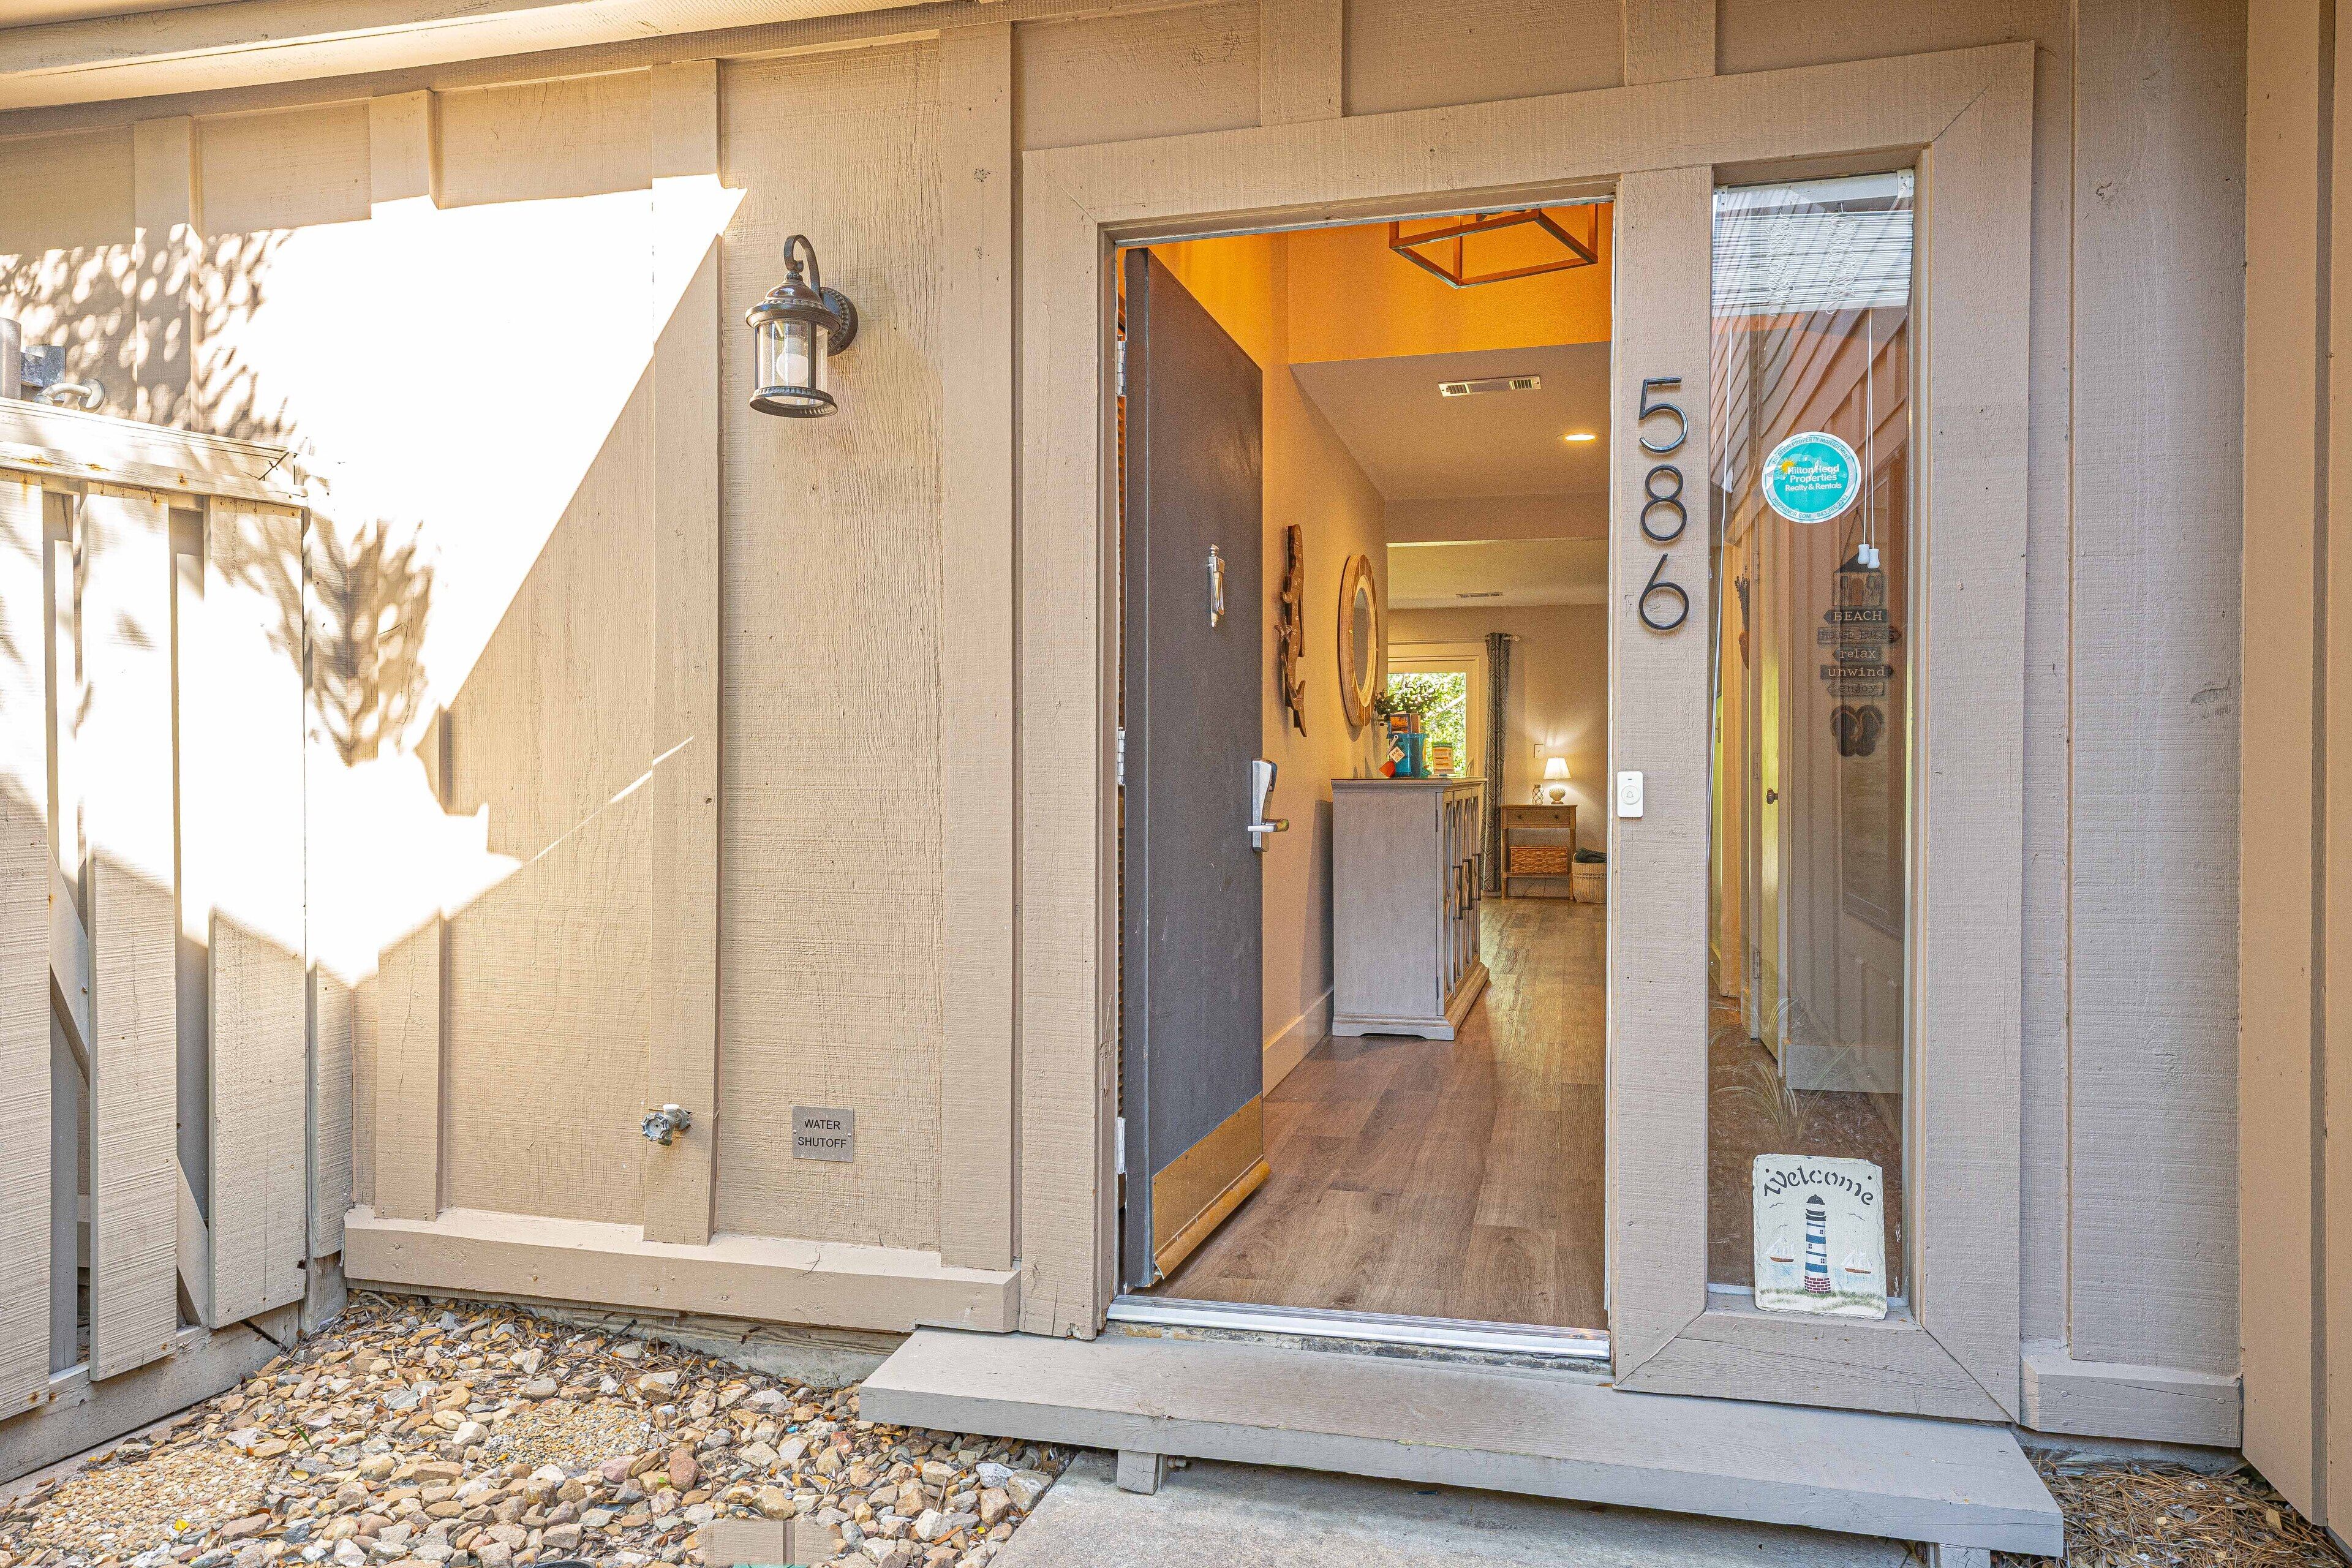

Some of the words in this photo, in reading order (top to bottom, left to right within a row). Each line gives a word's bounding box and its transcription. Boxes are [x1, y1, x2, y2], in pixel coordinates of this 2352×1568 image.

[1771, 445, 1792, 464] VACATION
[1792, 437, 1819, 447] PROPERTY
[1820, 438, 1850, 460] MANAGEMENT
[1787, 466, 1814, 475] Hilton
[1815, 464, 1839, 473] Head
[1790, 473, 1837, 483] Properties
[1639, 376, 1689, 630] 586
[1833, 611, 1882, 621] BEACH
[1840, 649, 1875, 658] relax
[1828, 666, 1886, 676] unwind
[1839, 683, 1877, 693] enjoy
[804, 1119, 841, 1130] WATER
[798, 1136, 847, 1148] SHUTOFF
[1764, 1166, 1874, 1205] Welcome
